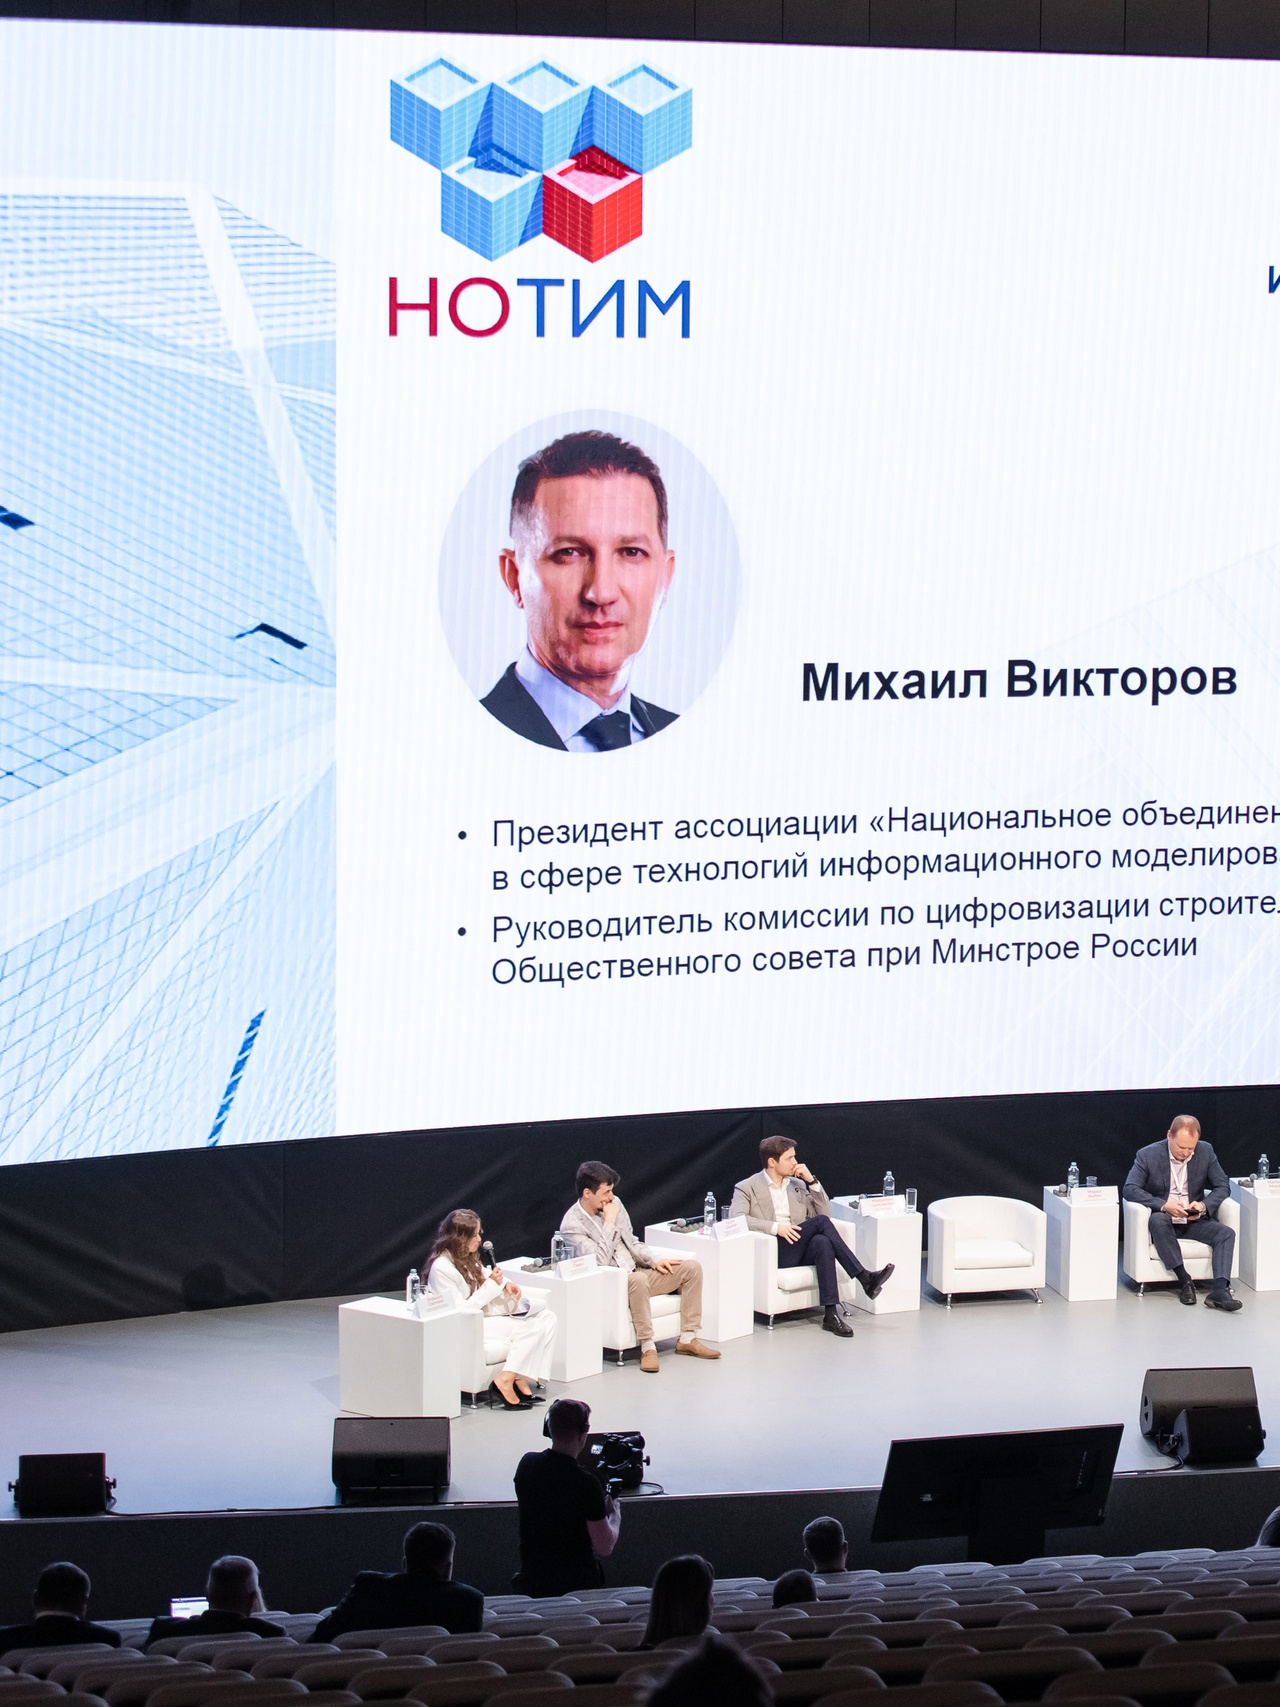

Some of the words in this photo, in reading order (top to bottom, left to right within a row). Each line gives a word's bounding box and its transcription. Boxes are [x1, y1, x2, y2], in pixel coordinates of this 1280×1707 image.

[389, 276, 691, 339] НОТИМ
[802, 662, 988, 702] Михаил
[1007, 659, 1238, 707] Викторов
[493, 819, 664, 853] Президент
[674, 814, 857, 844] ассоциации
[869, 806, 1112, 838] «Национальное
[492, 870, 509, 891] в
[520, 861, 622, 895] сфере
[632, 851, 808, 884] технологий
[820, 849, 1102, 882] информационного
[493, 913, 713, 949] Руководитель
[724, 906, 869, 932] комиссии
[880, 905, 915, 926] по
[926, 896, 1150, 930] цифровизации
[491, 953, 742, 989] Общественного
[752, 948, 856, 972] совета
[867, 945, 921, 973] при
[932, 937, 1080, 968] Минстрое
[1091, 933, 1197, 959] России
